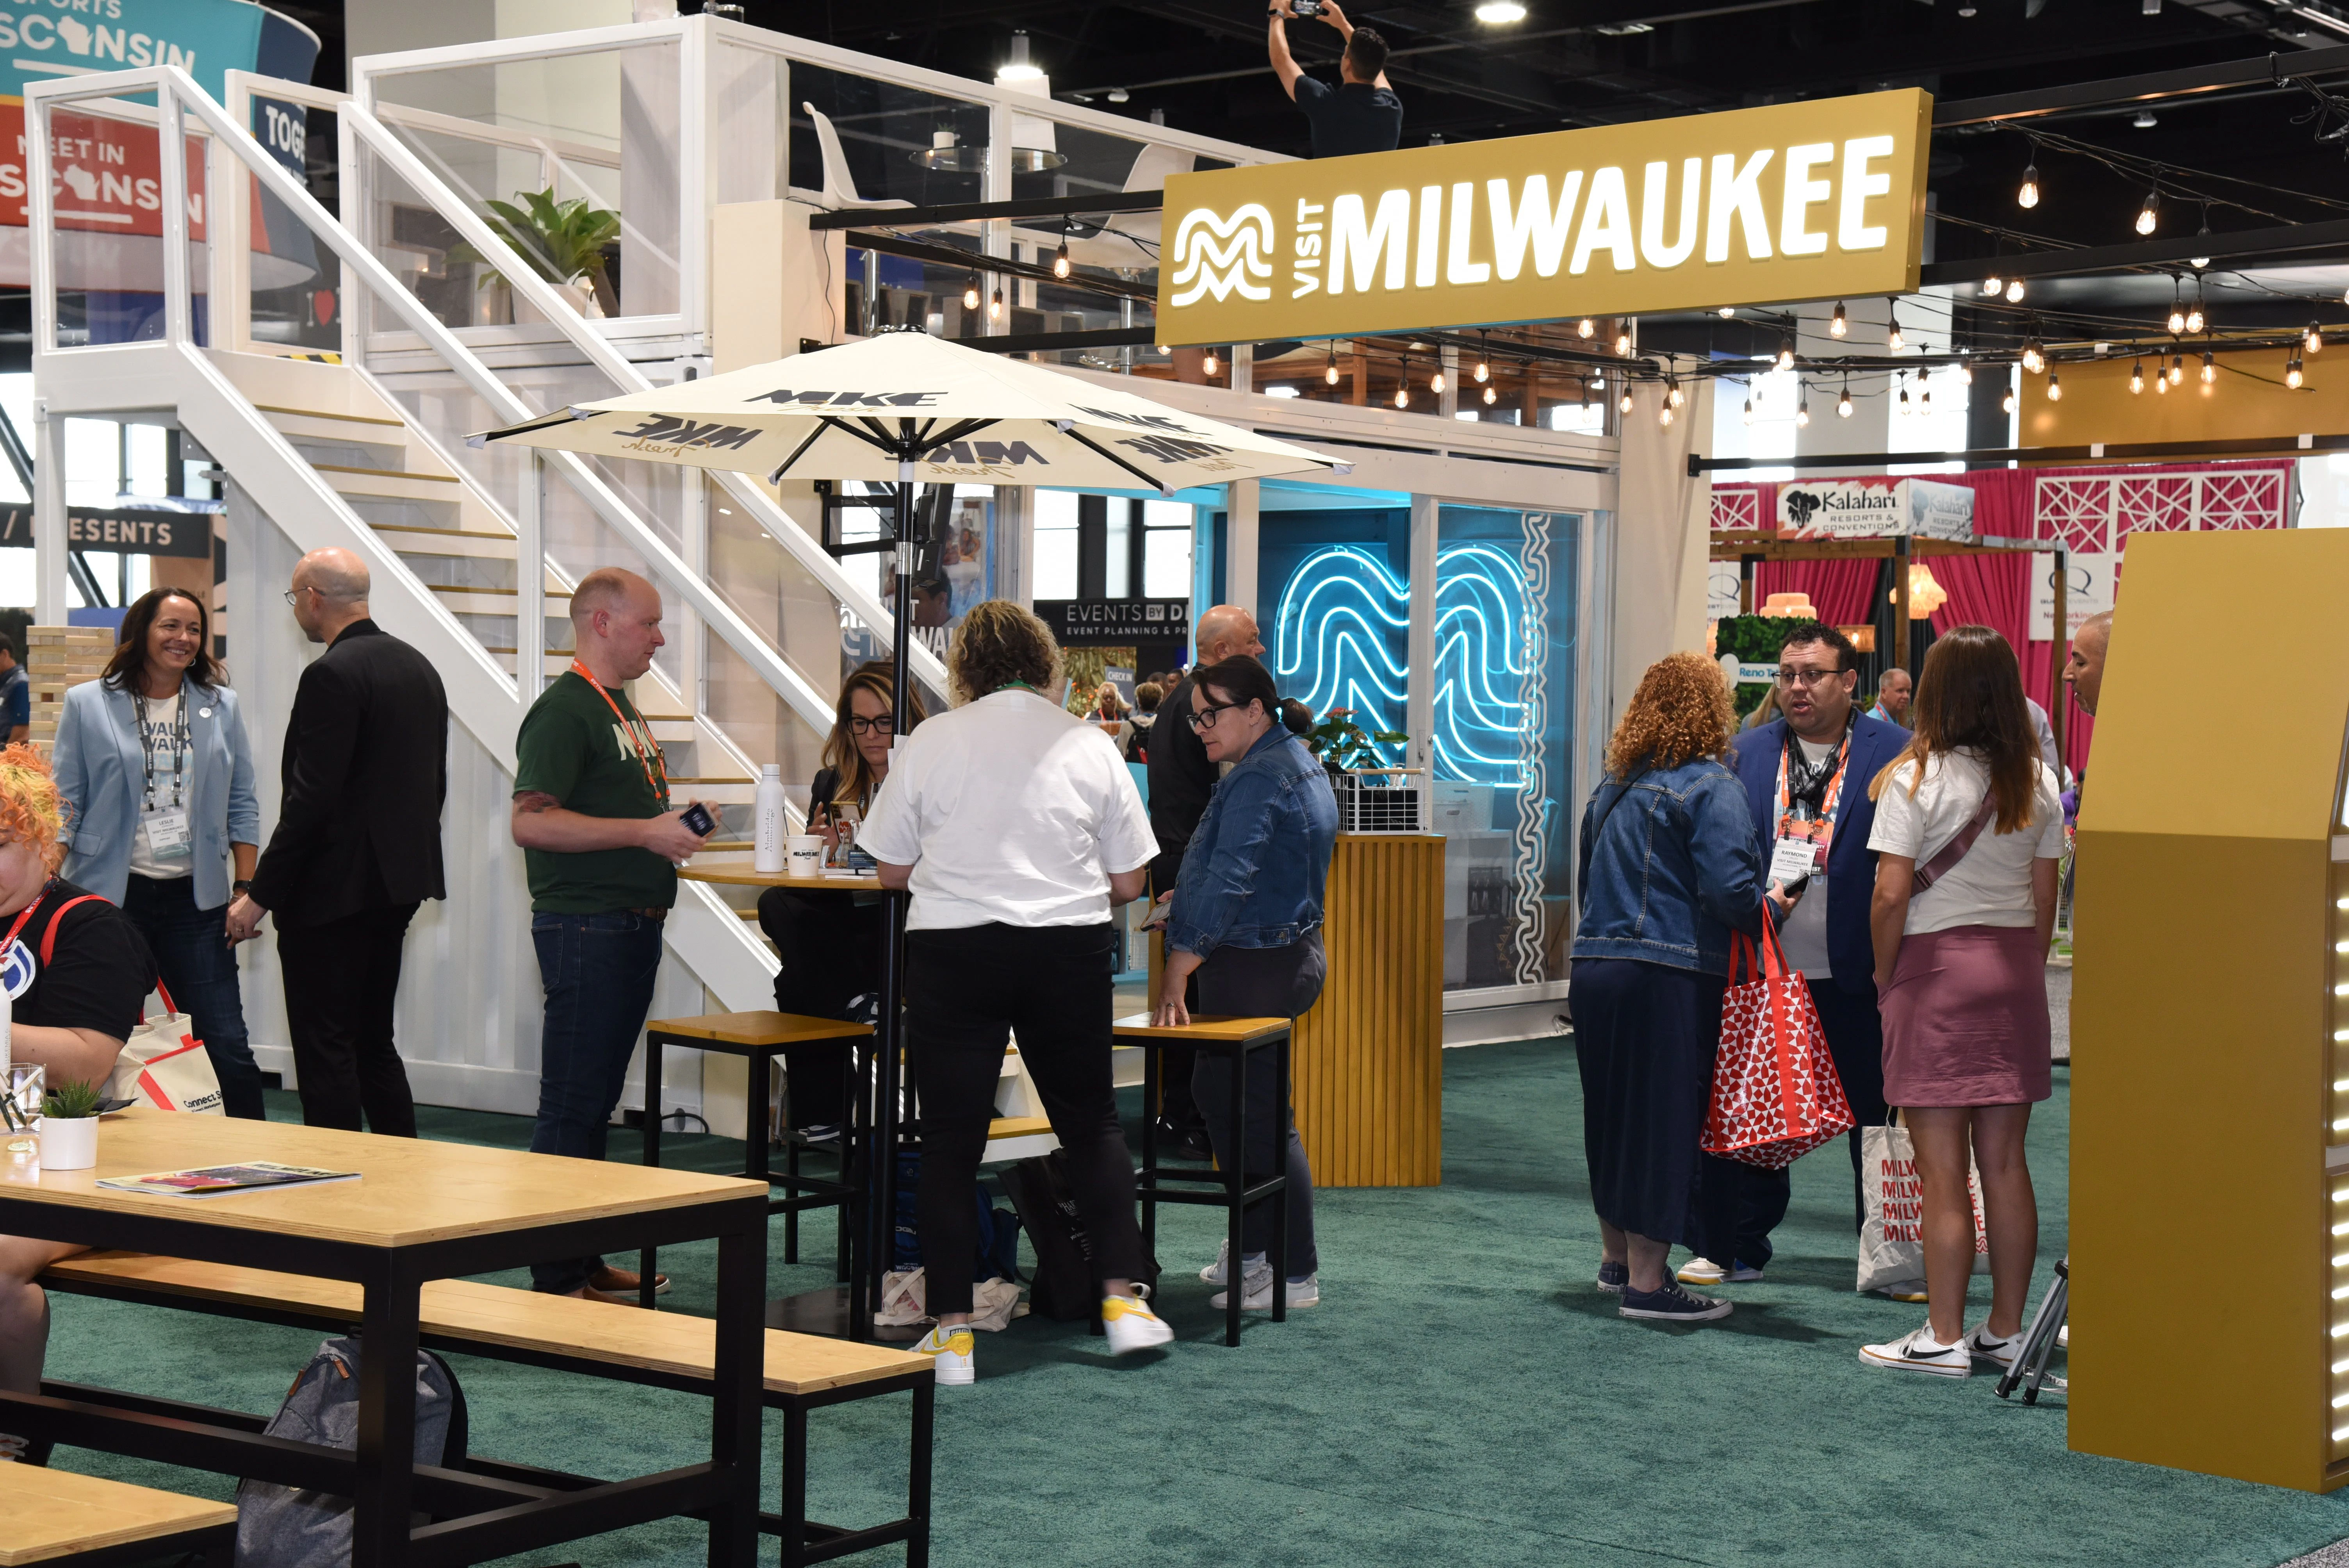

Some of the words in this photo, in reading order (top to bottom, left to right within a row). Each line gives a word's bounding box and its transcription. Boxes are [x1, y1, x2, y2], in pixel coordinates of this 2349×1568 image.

[99, 142, 124, 165] IN
[1292, 197, 1324, 299] VISIT
[1326, 134, 1893, 295] MILWAUKEE
[740, 389, 949, 406] MKE
[1822, 490, 1896, 512] Kalahari
[1823, 521, 1899, 531] CONVENTIONS
[1830, 514, 1882, 522] RESORTS
[30, 515, 172, 546] ESENTS
[1067, 605, 1141, 621] EVENTS
[1149, 608, 1162, 617] BY
[1067, 627, 1099, 635] EVENT
[1105, 627, 1158, 635] PLANNING
[1164, 627, 1169, 635] &
[1740, 668, 1764, 677] Reno
[184, 1093, 216, 1108] Connect
